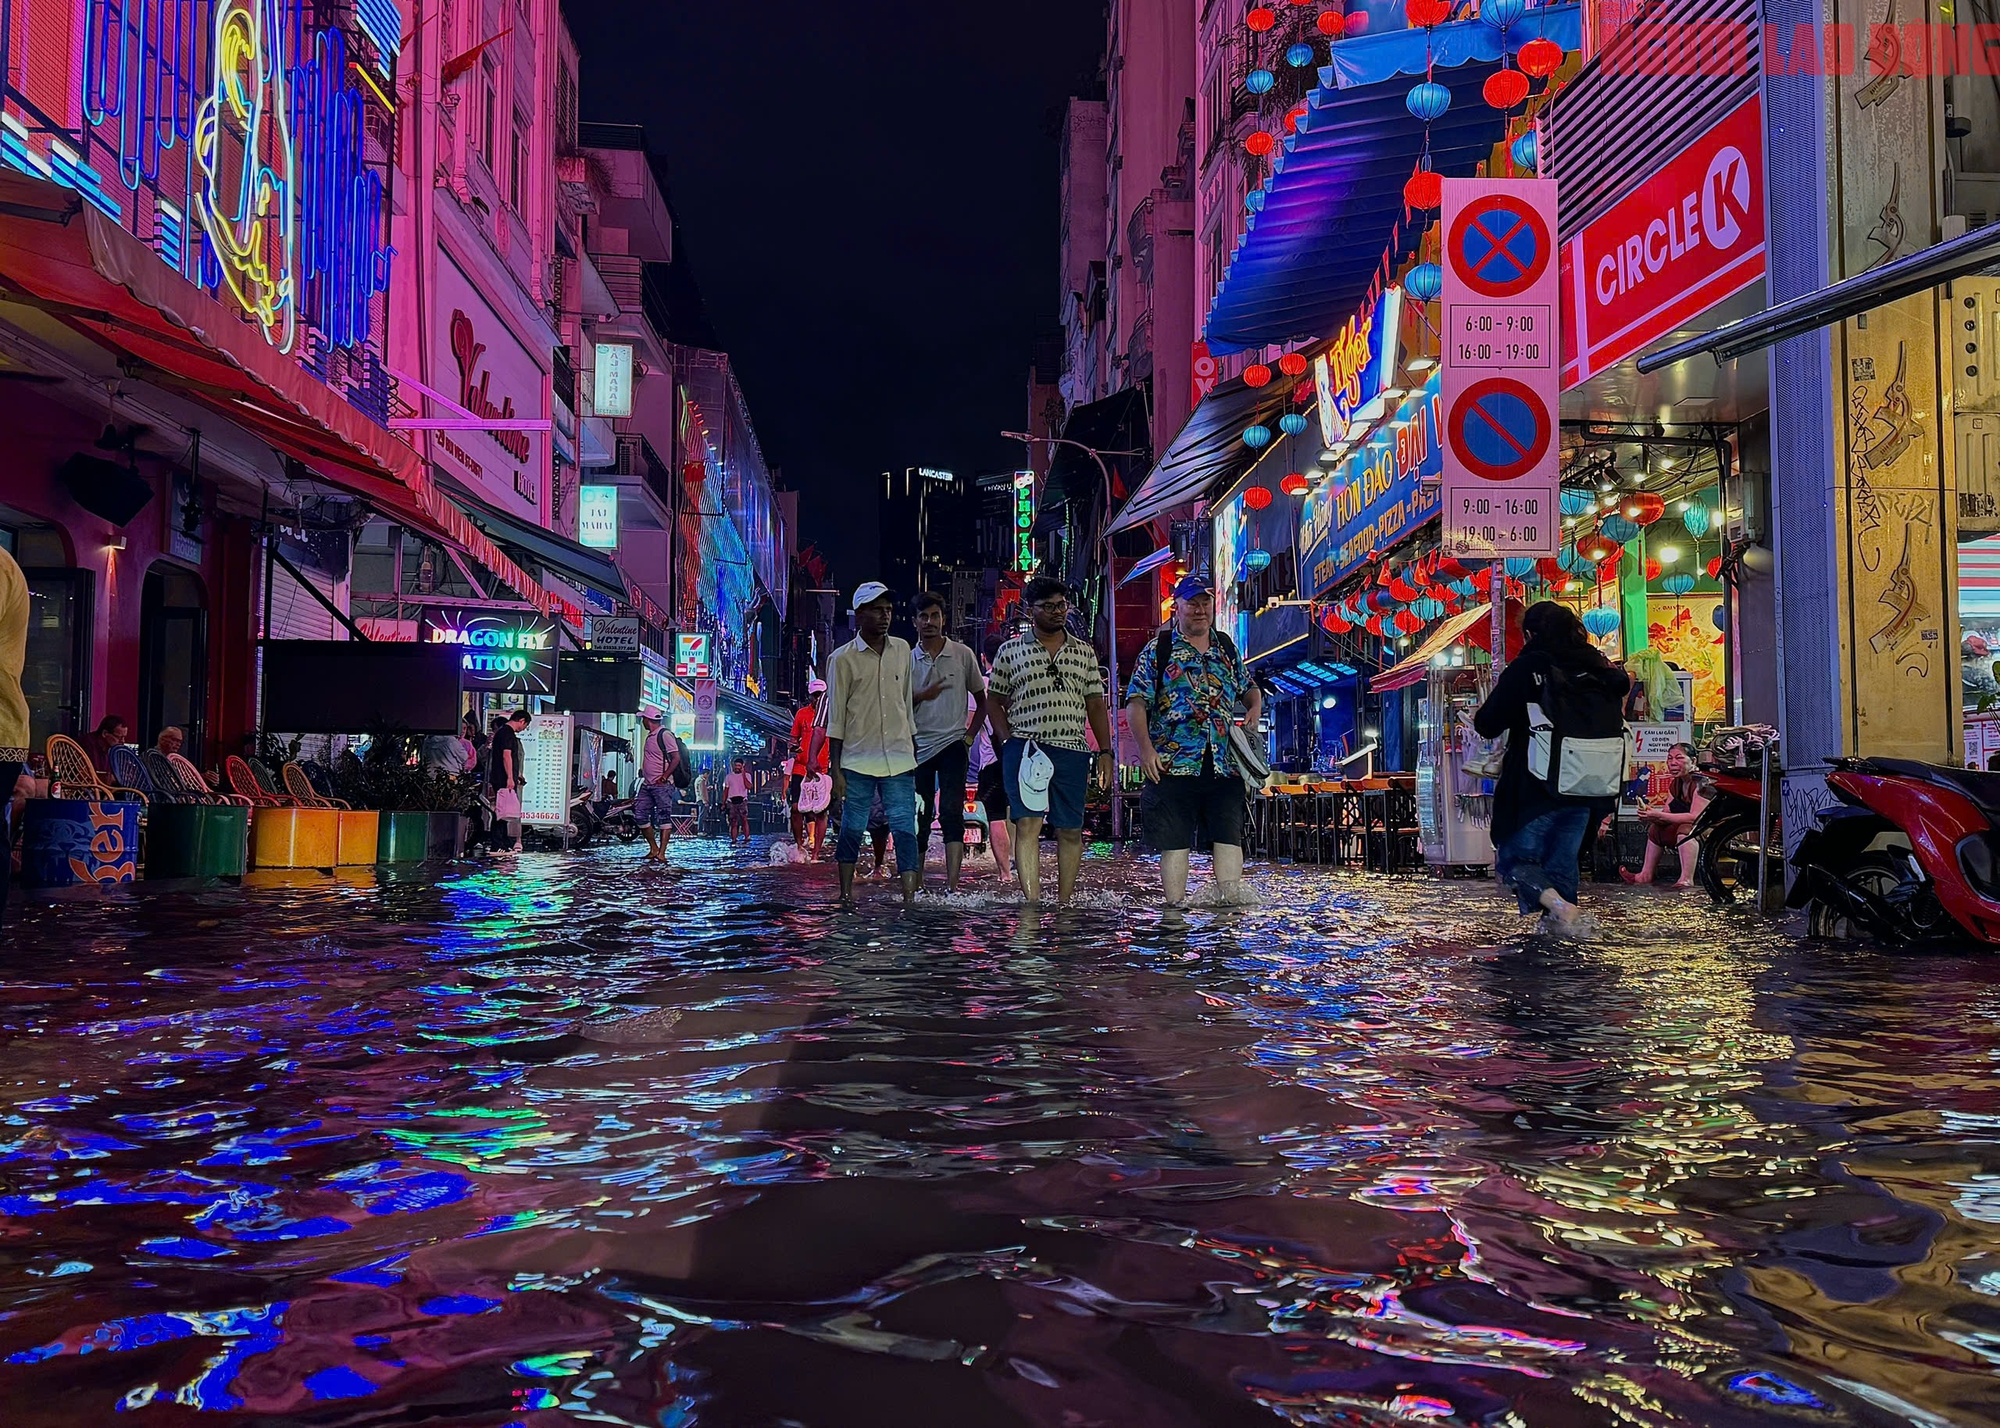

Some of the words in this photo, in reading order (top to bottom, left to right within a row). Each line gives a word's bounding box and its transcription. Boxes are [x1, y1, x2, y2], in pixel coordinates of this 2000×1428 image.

[1596, 191, 1700, 306] CIRCLE
[1702, 146, 1750, 250] K
[1466, 316, 1493, 331] 6:00
[1507, 316, 1533, 331] 9:00
[1329, 314, 1372, 407] Tiger
[1459, 344, 1491, 359] 16:00
[1506, 344, 1539, 359] 19:00
[1194, 357, 1215, 398] OY
[609, 371, 618, 407] MAHAL
[918, 468, 953, 481] LANCASTER
[1463, 499, 1490, 514] 9:00
[1505, 499, 1538, 514] 16:00
[1463, 526, 1496, 541] 19:00
[1510, 526, 1537, 541] 6:00
[1018, 533, 1031, 571] TÂY
[1313, 556, 1336, 589] STEAK
[1378, 500, 1406, 542] PIZZA
[594, 619, 637, 635] Valentine
[432, 628, 513, 648] DRAGON
[517, 631, 548, 650] FLY
[597, 636, 634, 645] HOTEL
[462, 654, 527, 673] ATTOO
